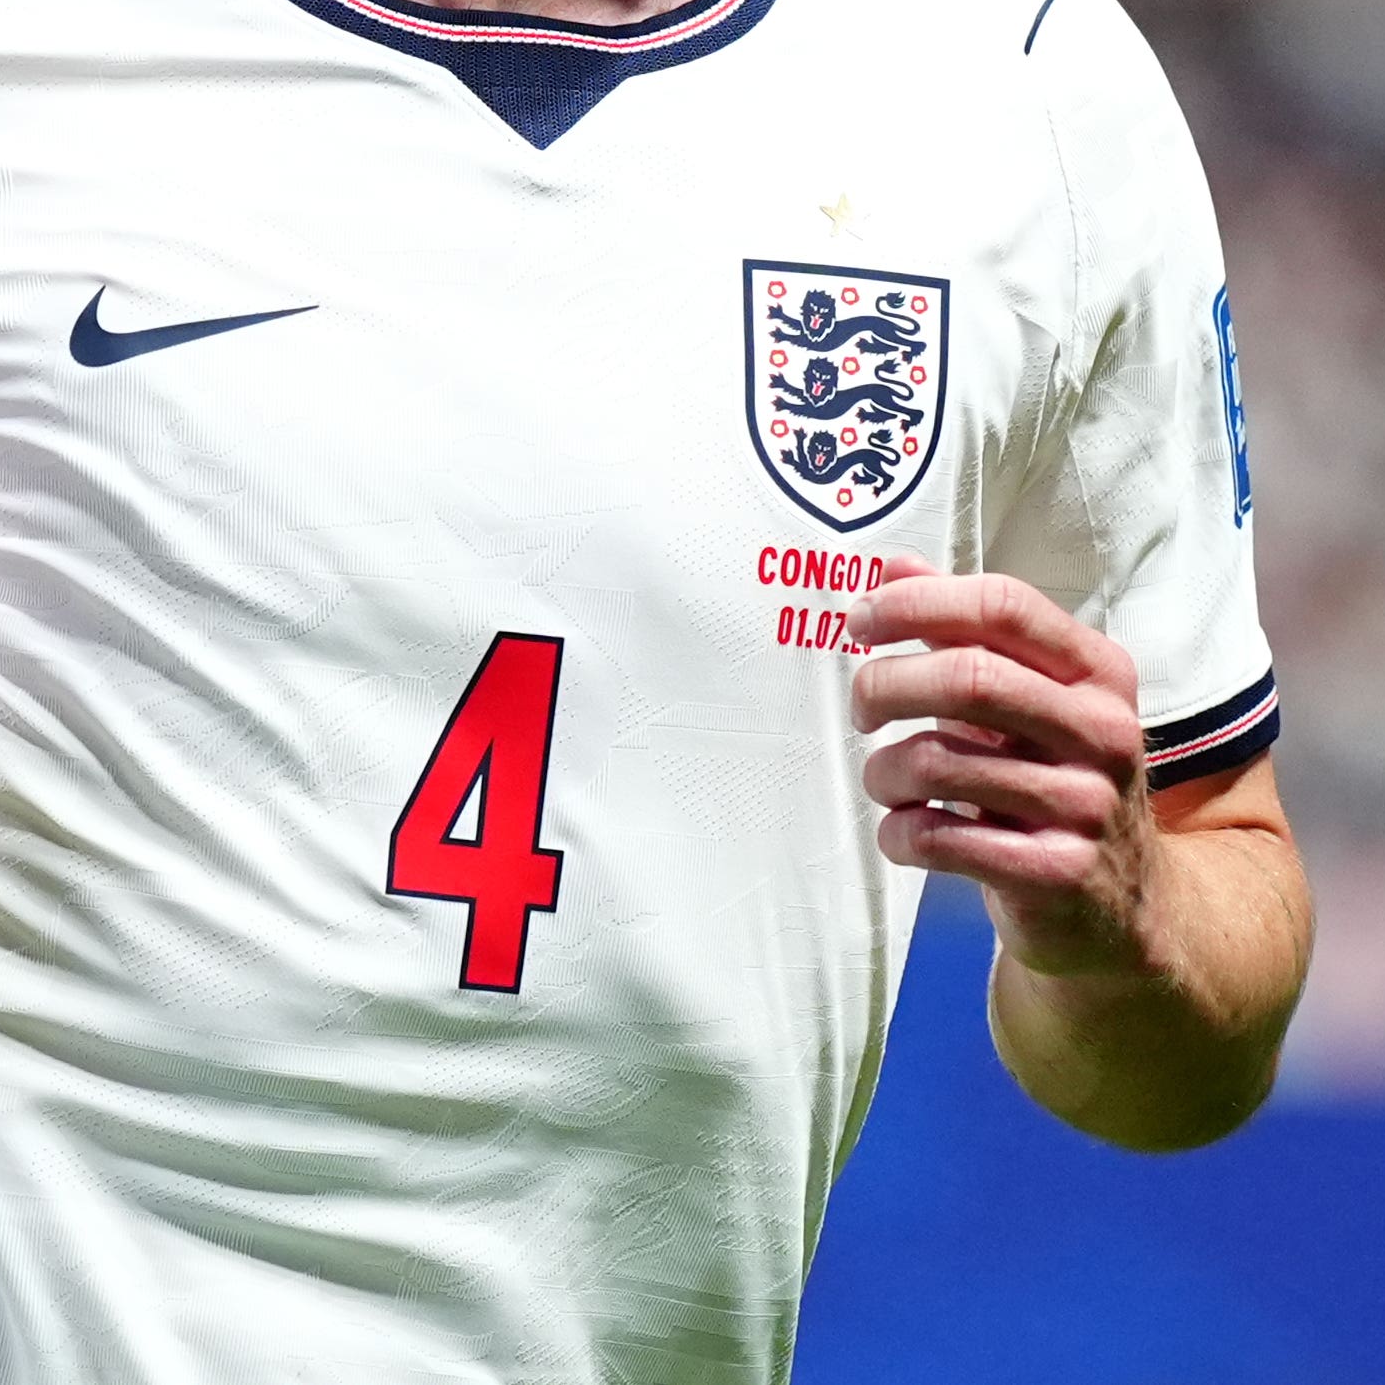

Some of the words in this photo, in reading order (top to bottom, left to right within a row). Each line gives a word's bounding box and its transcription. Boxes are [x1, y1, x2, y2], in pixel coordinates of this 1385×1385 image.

[758, 546, 861, 592] CONGO
[777, 606, 871, 655] 01.07.
[385, 631, 564, 994] 4
